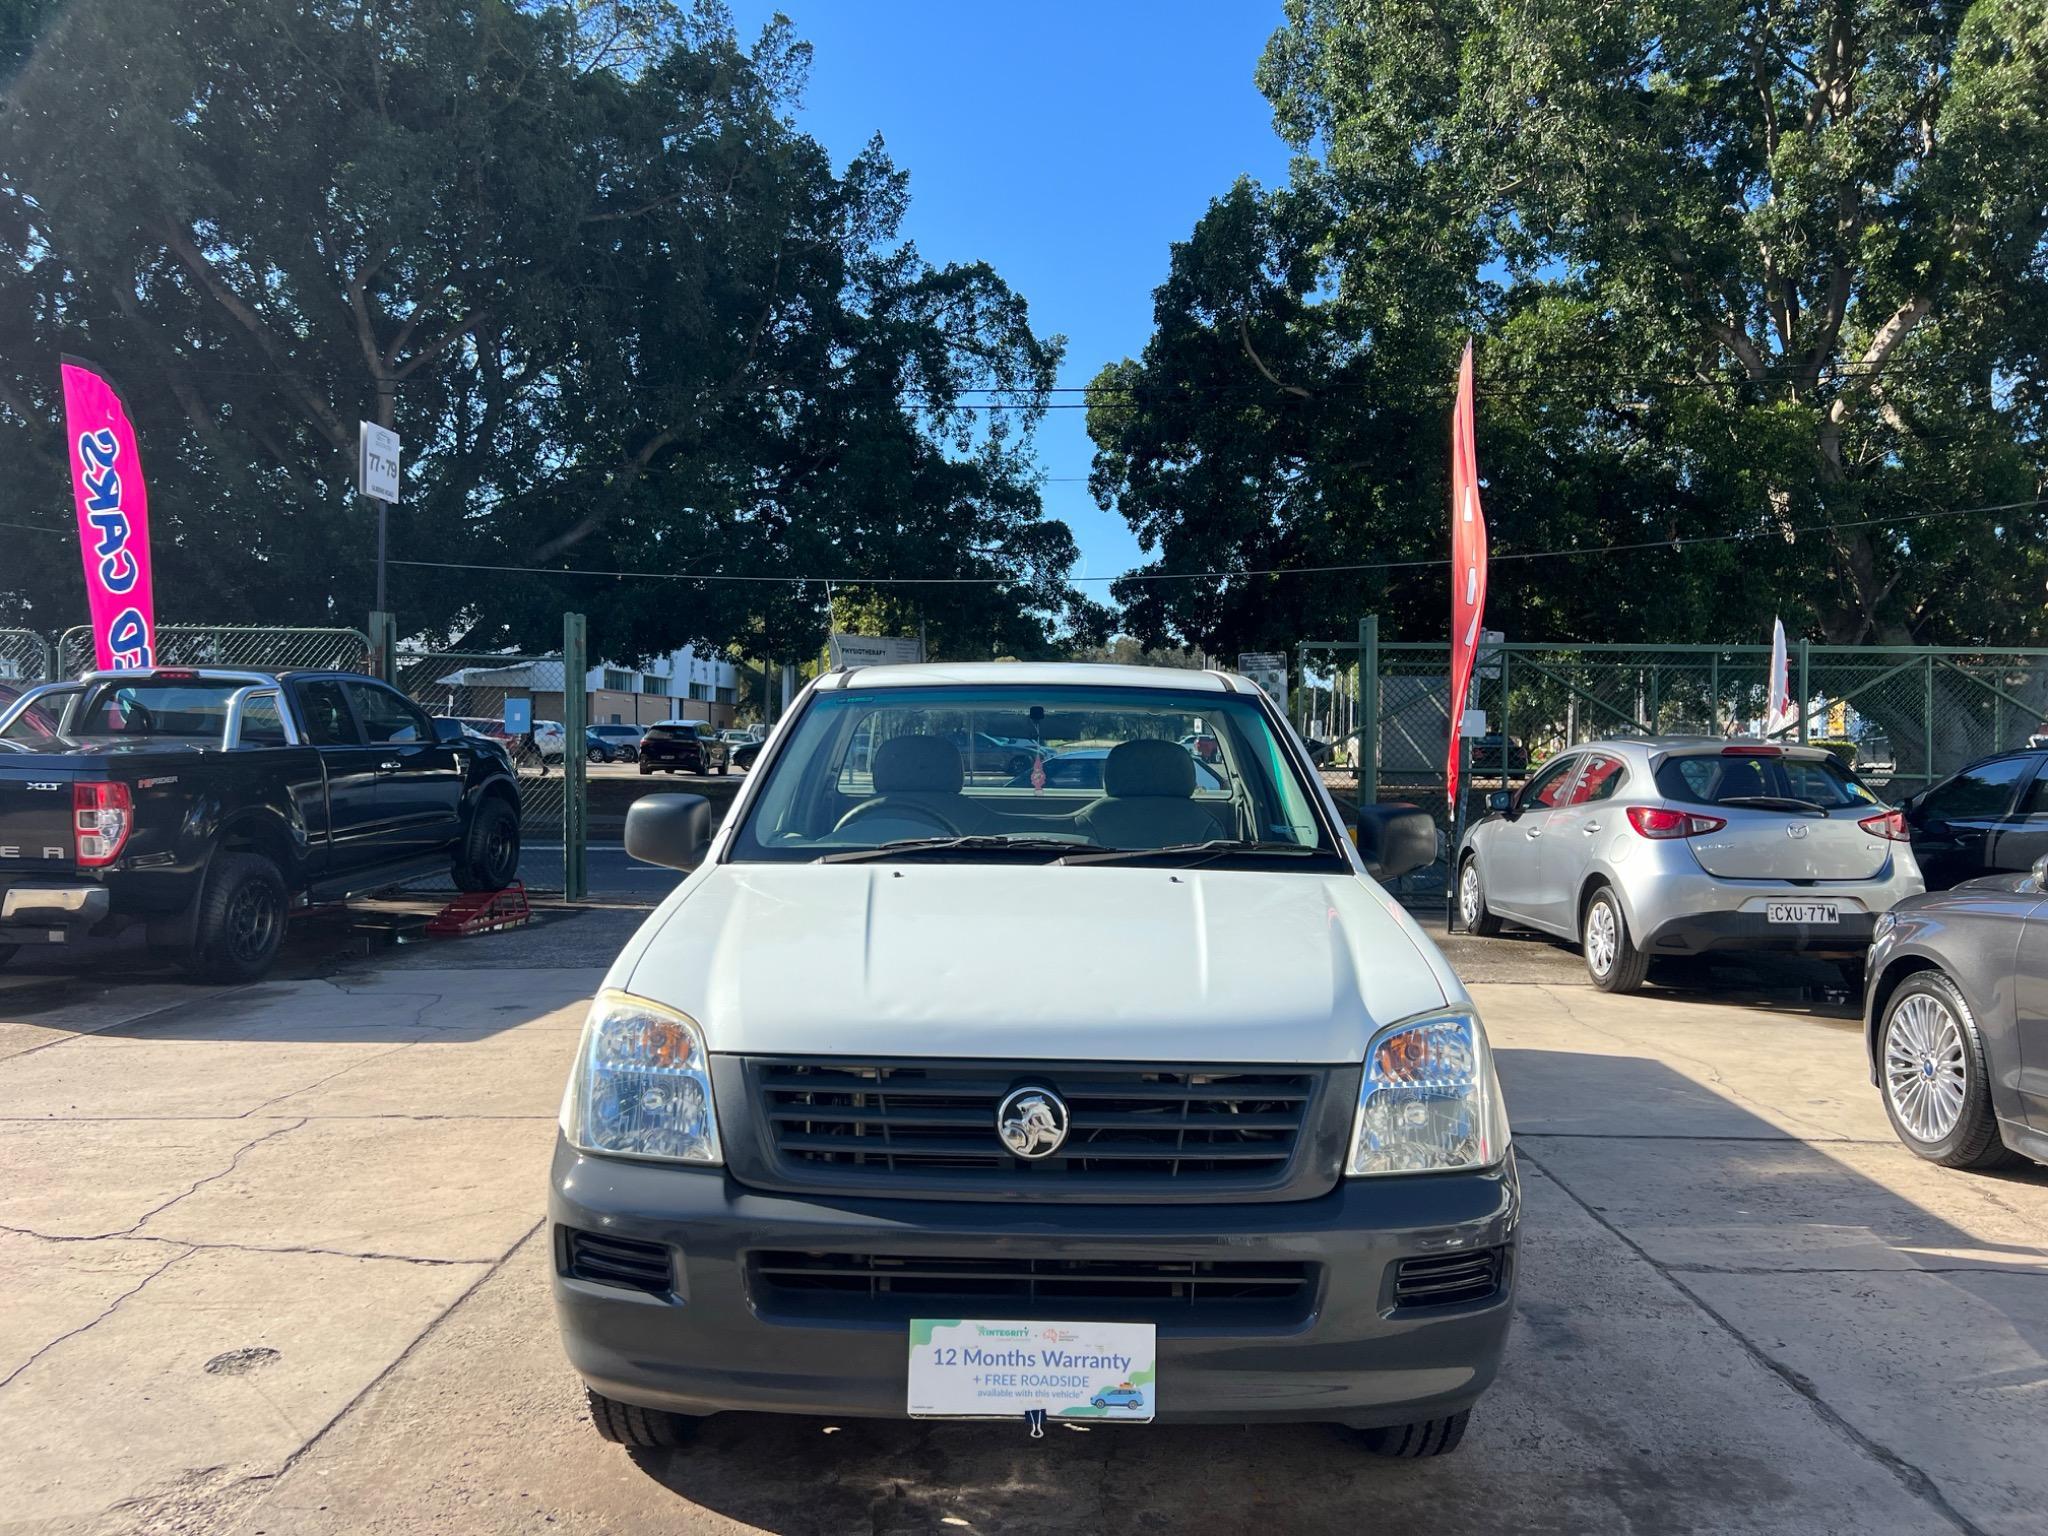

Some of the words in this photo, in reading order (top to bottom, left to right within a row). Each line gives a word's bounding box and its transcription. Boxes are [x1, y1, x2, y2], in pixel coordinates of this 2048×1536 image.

[985, 1328, 1030, 1337] INTEGRITY
[934, 1348, 957, 1366] 12
[964, 1349, 1036, 1368] Months
[1042, 1350, 1131, 1373] Warranty
[985, 1374, 1017, 1387] FREE
[1021, 1375, 1090, 1388] ROADSIDE
[977, 1389, 1014, 1398] available
[1015, 1388, 1032, 1398] with
[1034, 1388, 1050, 1398] this
